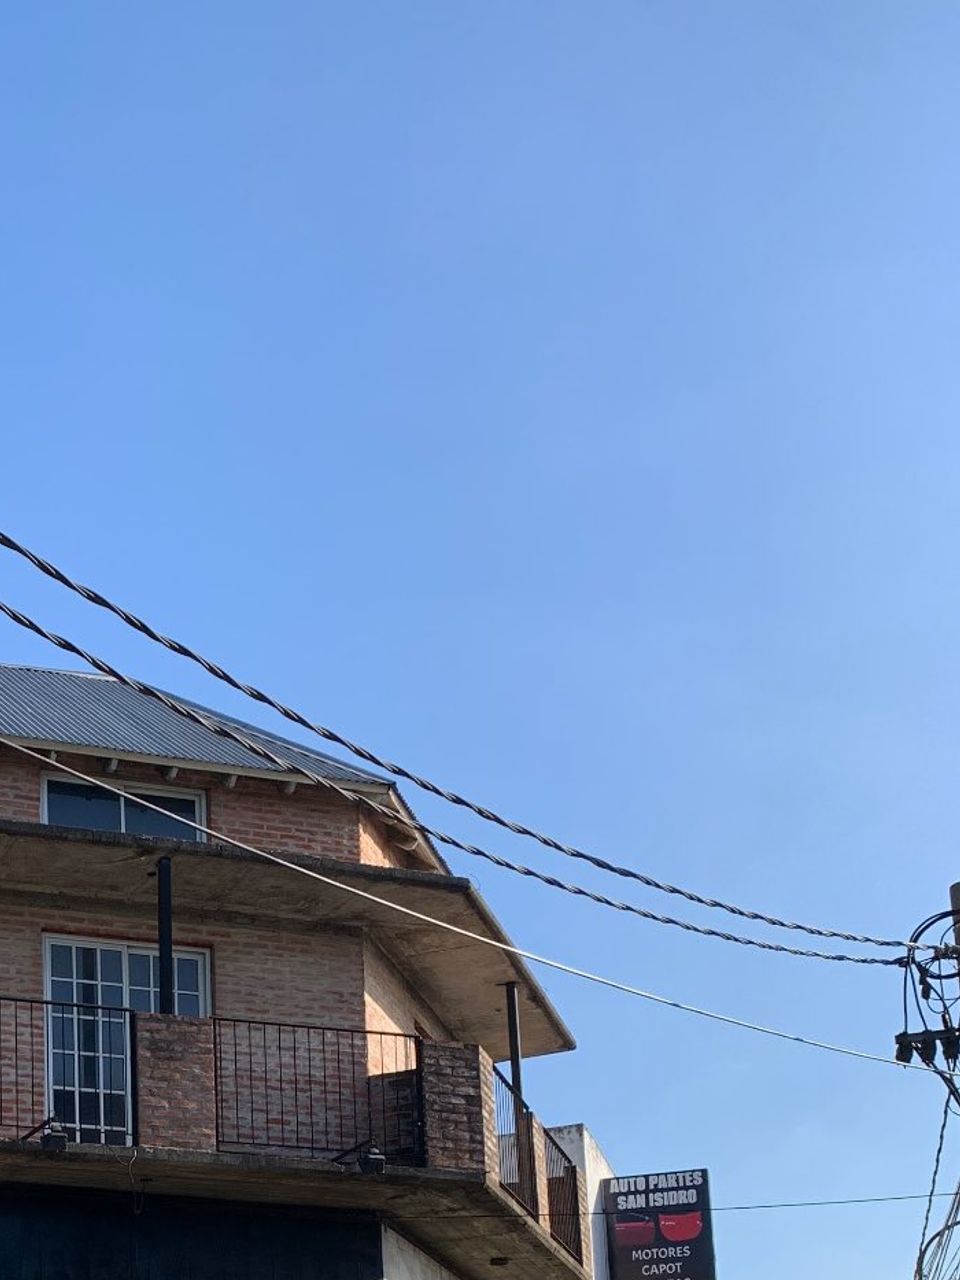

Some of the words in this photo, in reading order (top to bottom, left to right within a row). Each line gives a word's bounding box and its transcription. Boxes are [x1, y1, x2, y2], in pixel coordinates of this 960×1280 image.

[610, 1177, 646, 1193] AUTO
[648, 1171, 704, 1189] PARTES
[617, 1193, 646, 1209] SAN
[649, 1188, 697, 1206] ISIDRO
[632, 1246, 691, 1260] MOTORES
[641, 1262, 682, 1275] CAPOT
